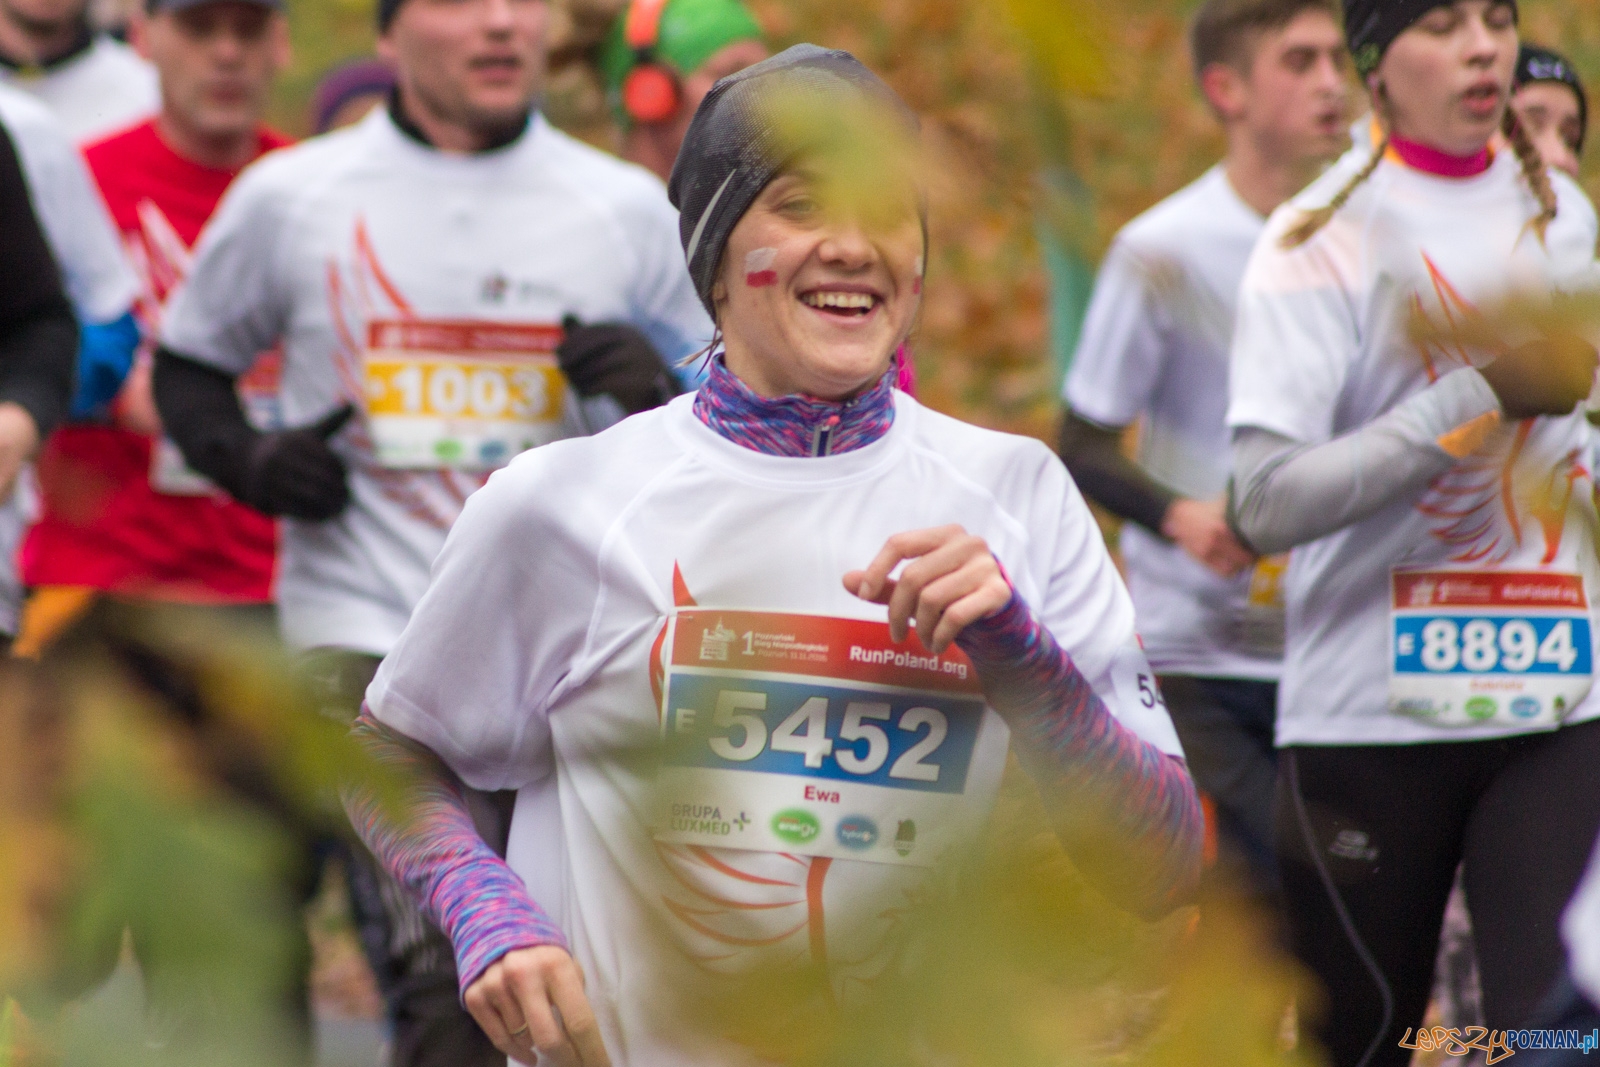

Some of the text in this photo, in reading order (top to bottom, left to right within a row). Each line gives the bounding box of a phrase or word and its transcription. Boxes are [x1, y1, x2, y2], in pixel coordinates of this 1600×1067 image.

[391, 365, 546, 418] 1003
[849, 645, 968, 679] RunPoland.org
[1420, 618, 1578, 672] 8894
[675, 689, 949, 782] E 5452
[804, 785, 841, 804] Ewa
[671, 818, 731, 836] LUXMED
[672, 804, 722, 820] GRUPA
